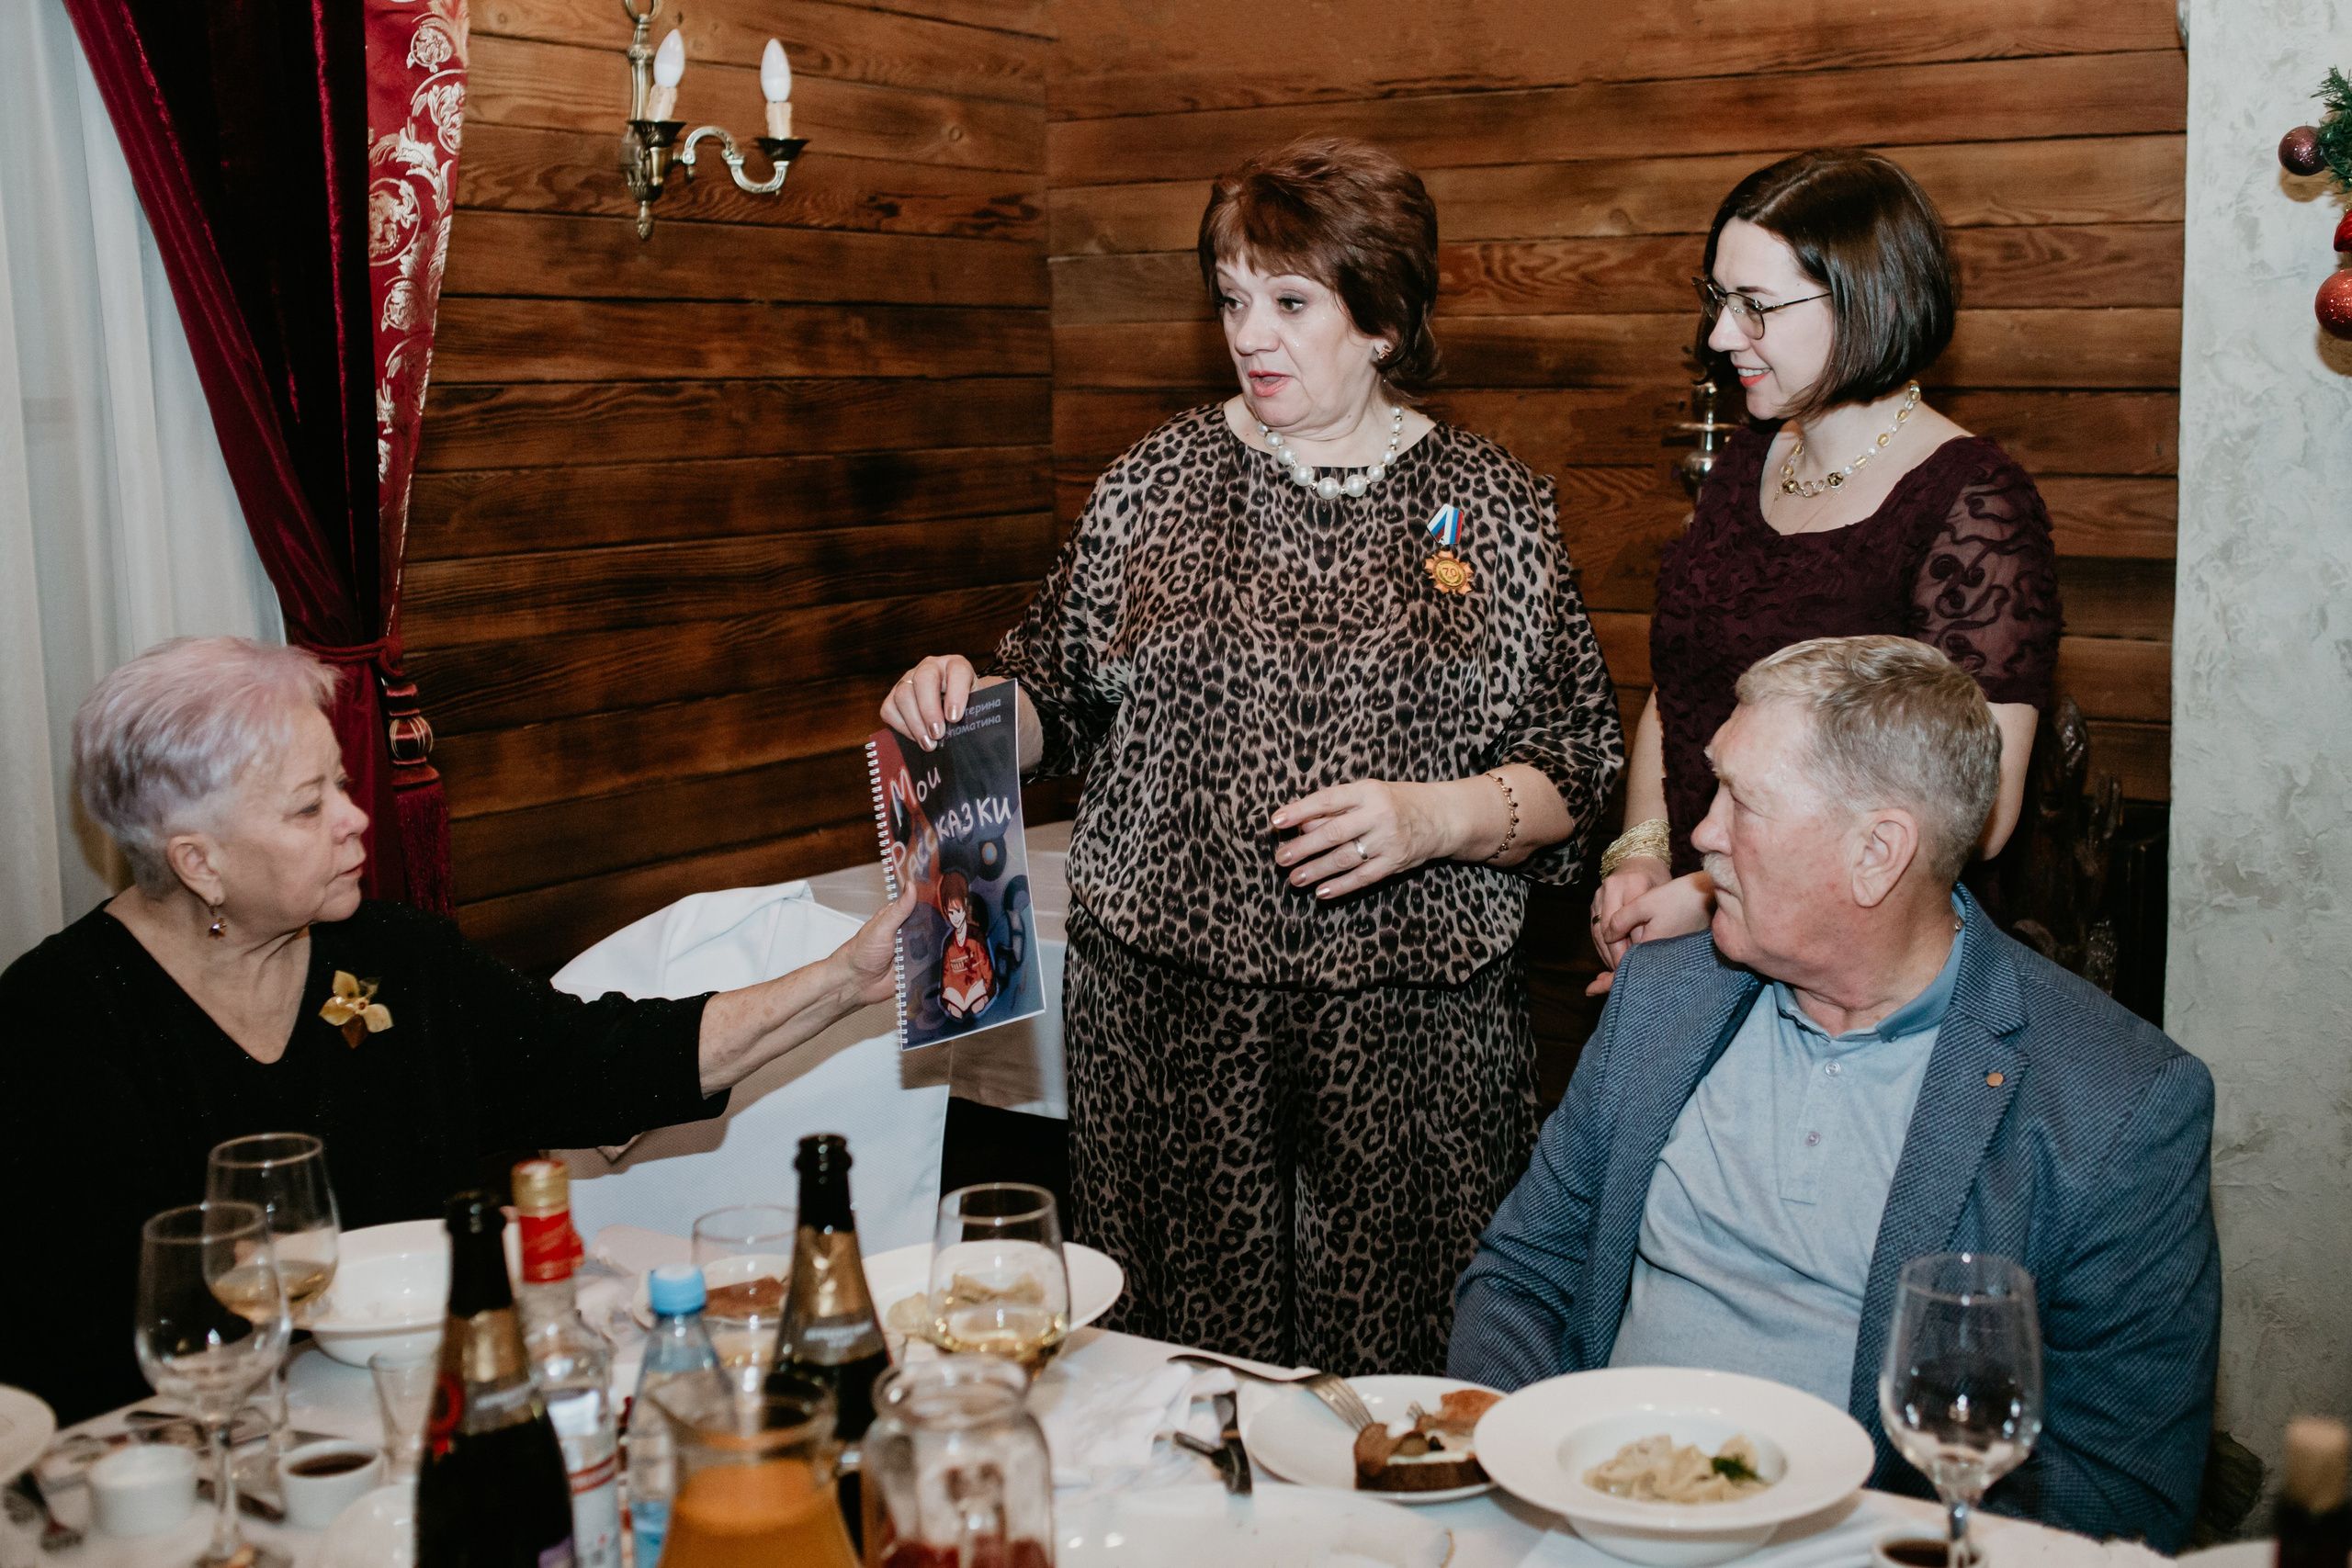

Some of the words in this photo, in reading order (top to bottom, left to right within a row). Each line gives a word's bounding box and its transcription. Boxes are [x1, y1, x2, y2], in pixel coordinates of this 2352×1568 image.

[1442, 567, 1458, 578] 70
[965, 698, 1001, 716] терина
[889, 766, 942, 828] Мои
